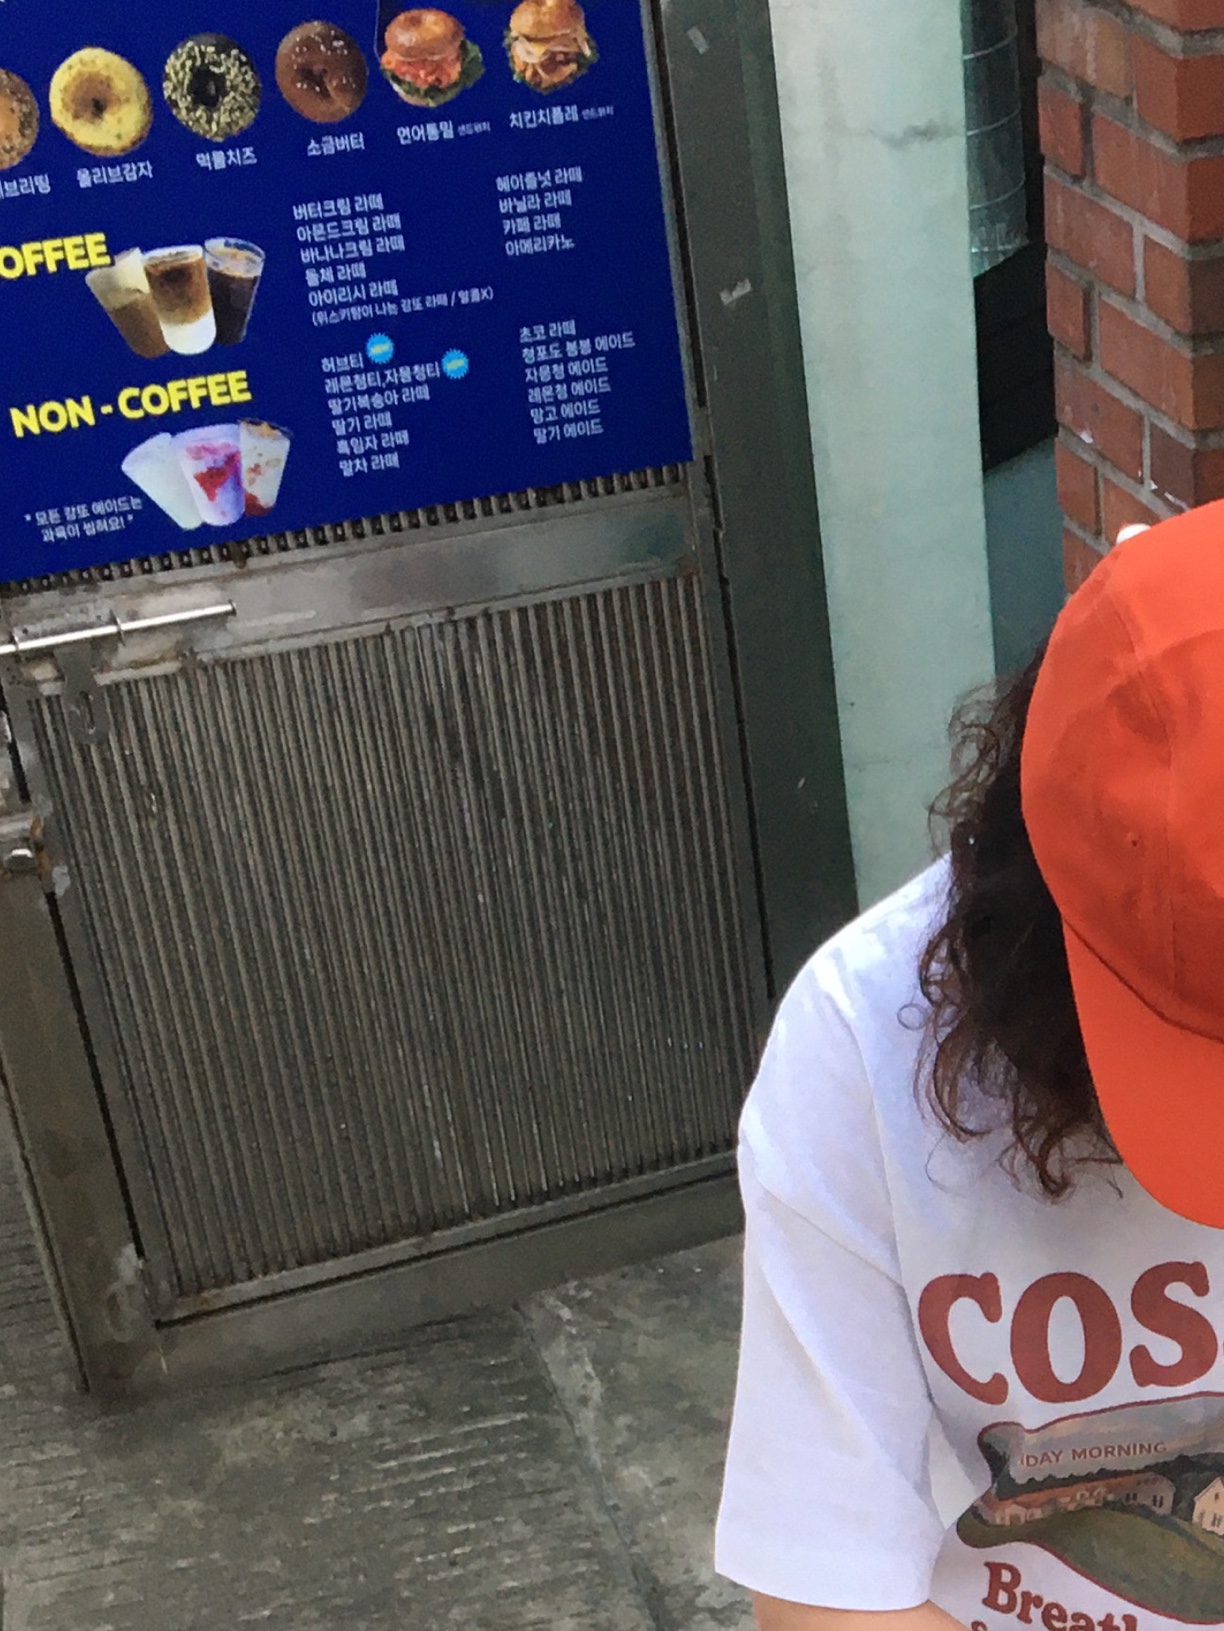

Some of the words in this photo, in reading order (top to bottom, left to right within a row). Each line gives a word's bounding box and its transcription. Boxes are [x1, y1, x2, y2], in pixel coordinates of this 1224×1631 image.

[306, 131, 366, 157] 소금버터
[76, 159, 154, 189] 올리브감자
[0, 173, 51, 200] 브리띵
[292, 197, 352, 221] 버터크림
[499, 193, 542, 214] 바닐라
[296, 217, 370, 243] 아몬드크림
[300, 238, 374, 264] 바나나크림
[504, 233, 576, 257] 아메리카노
[308, 283, 367, 307] 아이리시
[594, 330, 636, 352] 에이드
[320, 351, 365, 374] 허브티
[567, 355, 609, 377] 에이드
[570, 375, 612, 396] 에이드
[9, 394, 97, 439] NON
[117, 369, 253, 420] COFFEE
[560, 398, 602, 419] 에이드
[562, 417, 605, 438] 에이드
[1020, 1450, 1063, 1467] DAY
[1071, 1442, 1168, 1461] MORNING
